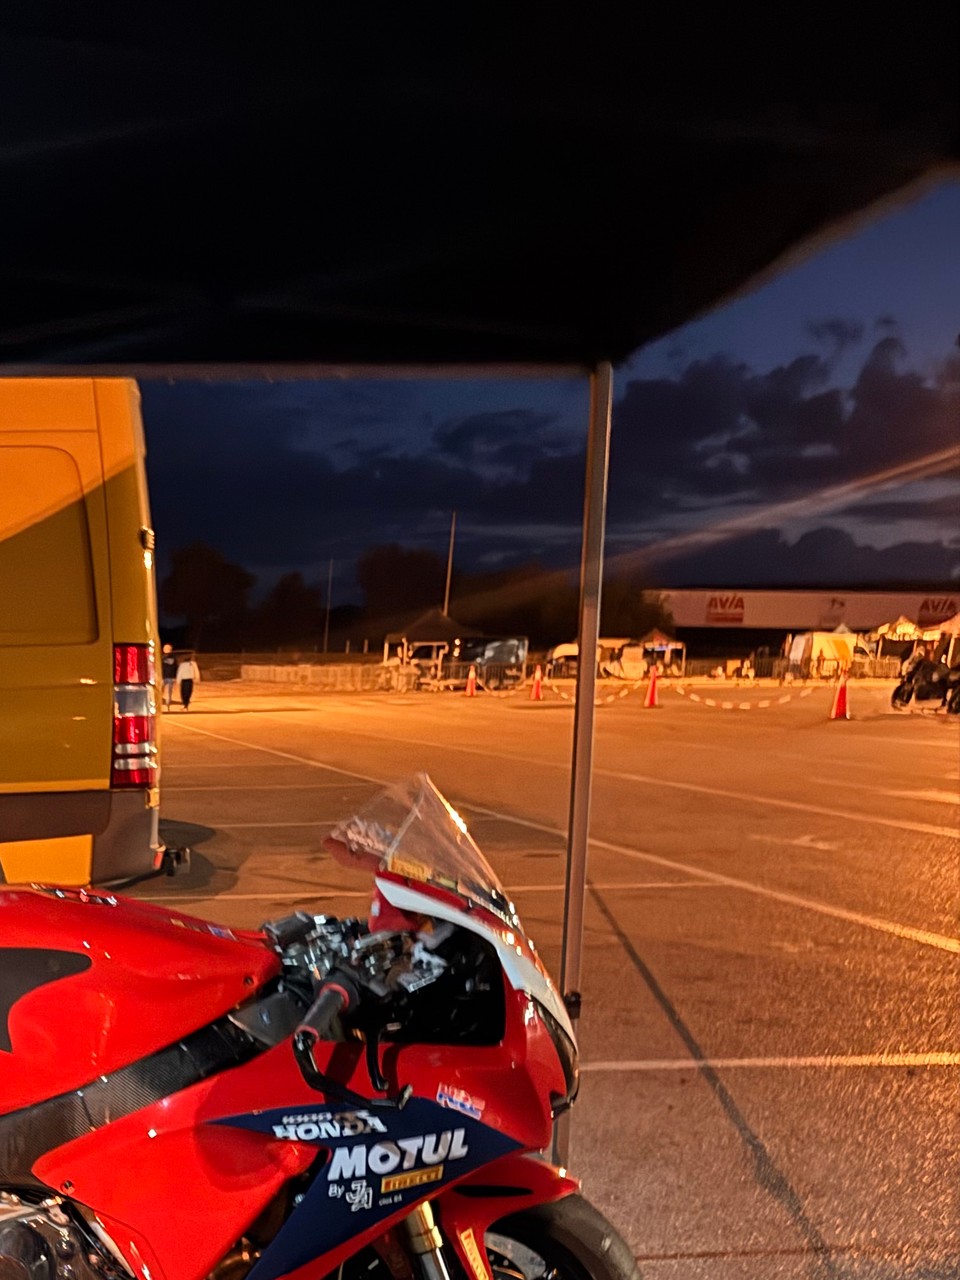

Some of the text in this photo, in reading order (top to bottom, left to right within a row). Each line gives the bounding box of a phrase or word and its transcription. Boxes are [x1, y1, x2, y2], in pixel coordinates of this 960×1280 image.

[708, 596, 745, 610] AVIA
[272, 1115, 387, 1141] HONDA
[327, 1128, 469, 1181] MOTUL
[328, 1183, 344, 1198] By
